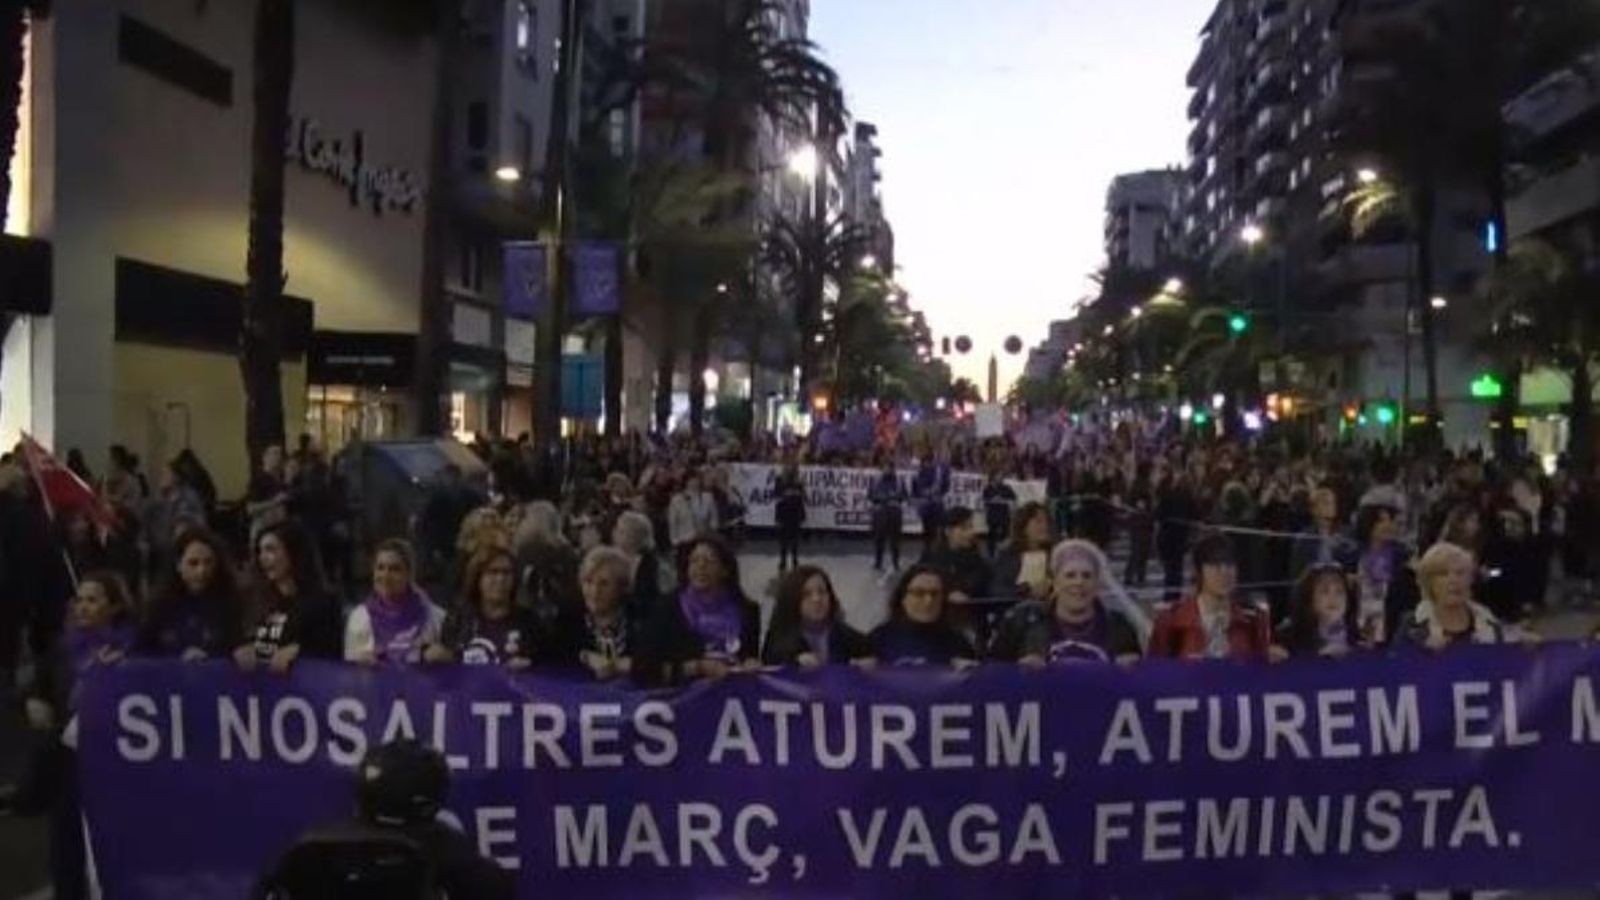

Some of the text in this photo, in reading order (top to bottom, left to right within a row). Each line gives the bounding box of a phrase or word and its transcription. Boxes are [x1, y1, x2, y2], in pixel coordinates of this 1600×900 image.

[116, 693, 186, 763] SI
[216, 694, 678, 770] NOSALTRES
[708, 697, 1067, 778] ATUREM,
[1099, 684, 1421, 765] ATUREM
[1451, 679, 1539, 750] EL
[553, 802, 806, 885] MARÇ,
[837, 803, 1061, 869] VAGA
[1093, 785, 1522, 865] FEMINISTA.
